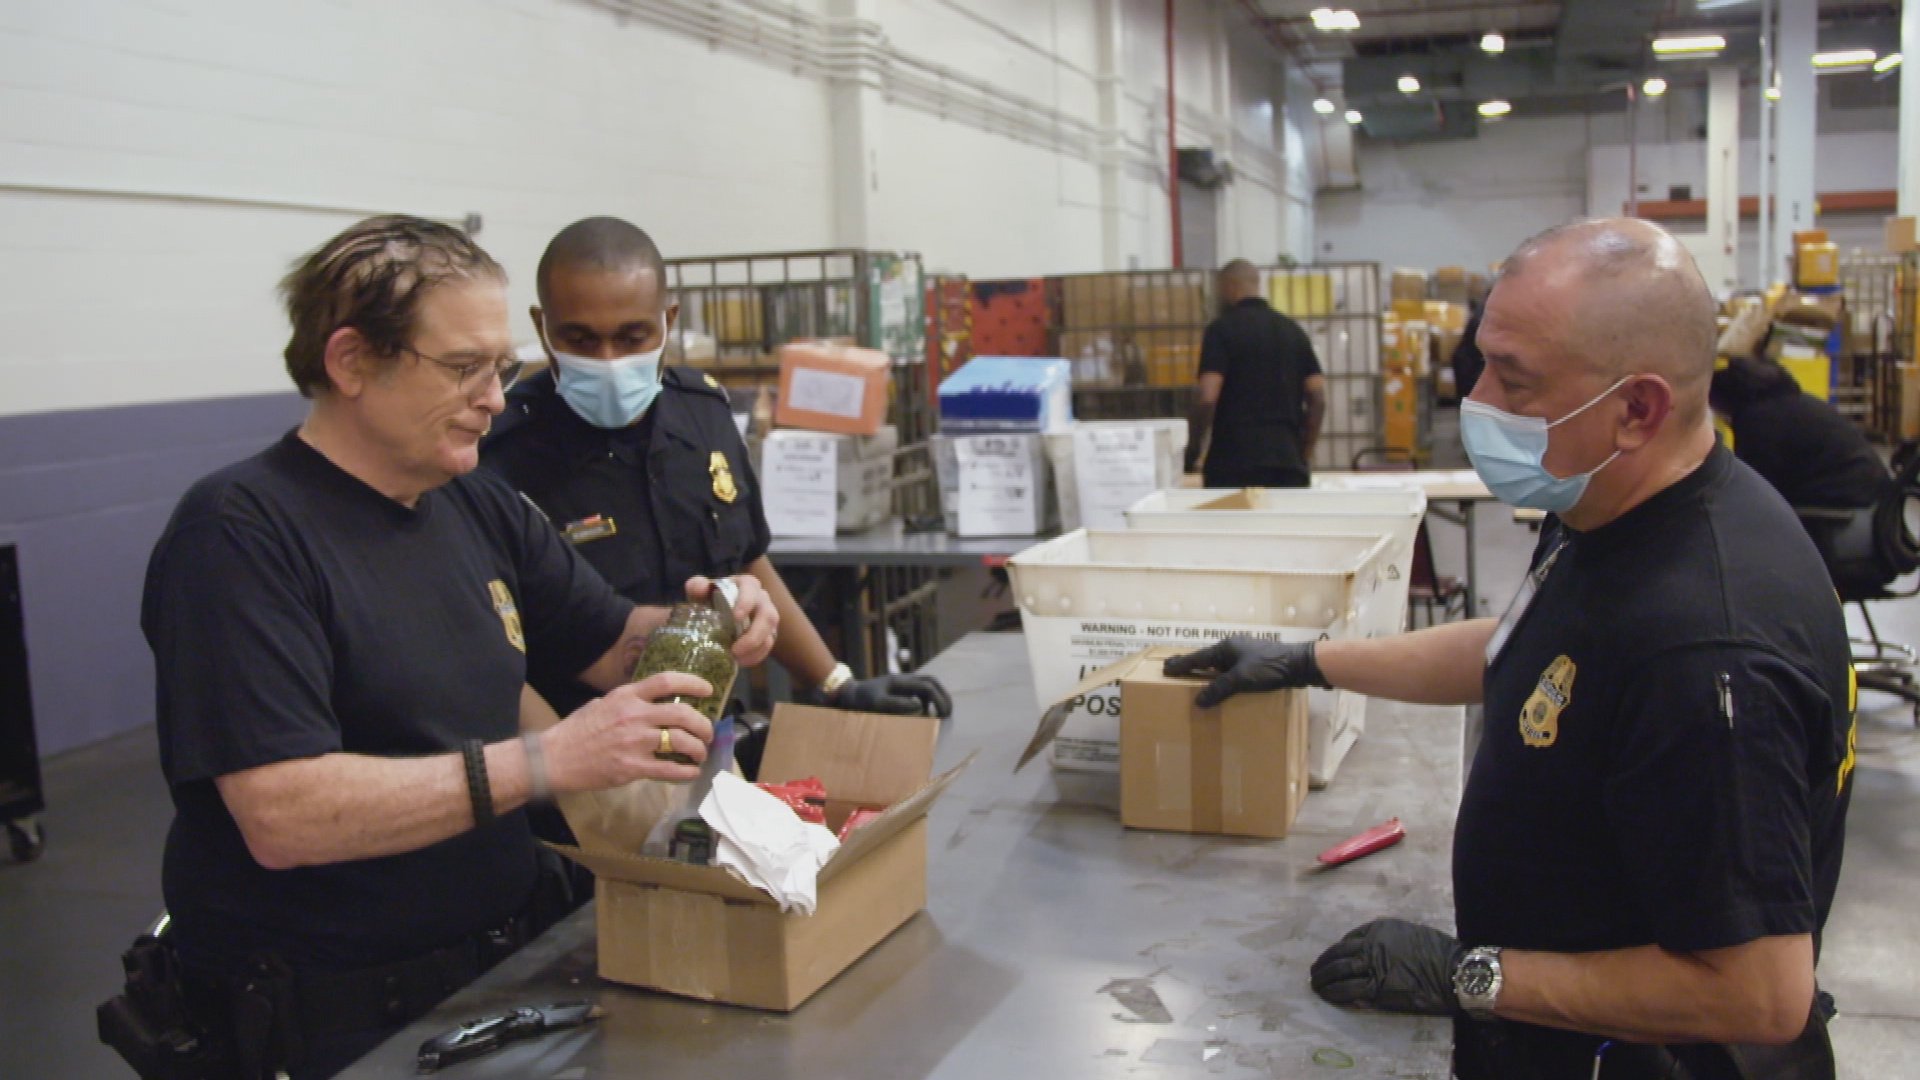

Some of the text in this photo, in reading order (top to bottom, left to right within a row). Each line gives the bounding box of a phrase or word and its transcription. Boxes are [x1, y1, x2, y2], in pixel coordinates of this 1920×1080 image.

[1081, 622, 1136, 635] WARNING
[1147, 624, 1171, 637] NOT
[1175, 626, 1200, 638] FOR
[1063, 694, 1121, 717] POS
